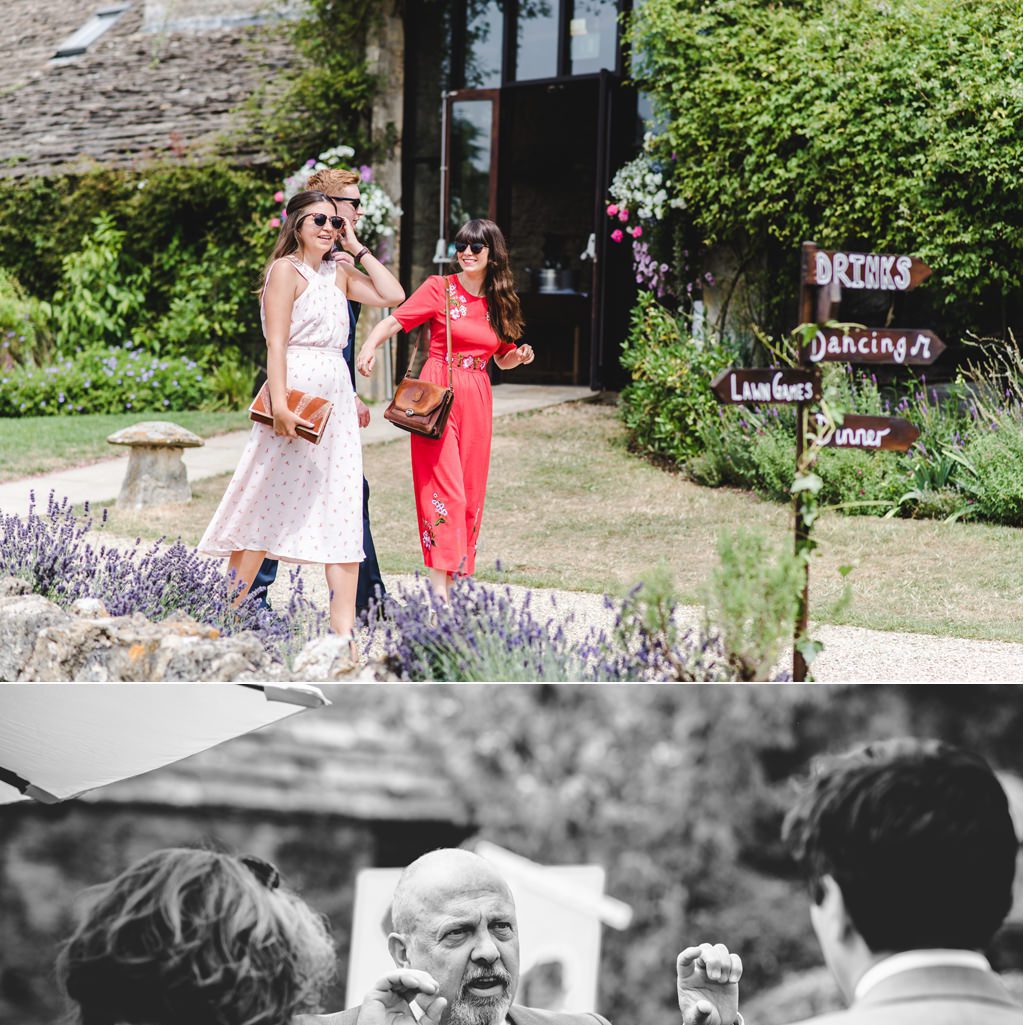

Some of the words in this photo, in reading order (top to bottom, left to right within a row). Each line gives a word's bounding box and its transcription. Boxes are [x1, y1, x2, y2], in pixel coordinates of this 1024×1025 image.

[815, 251, 913, 291] DRINKS
[809, 330, 906, 364] Dancing
[730, 373, 771, 402] LAWN
[772, 371, 814, 402] GAMES
[805, 413, 891, 447] Dinner
